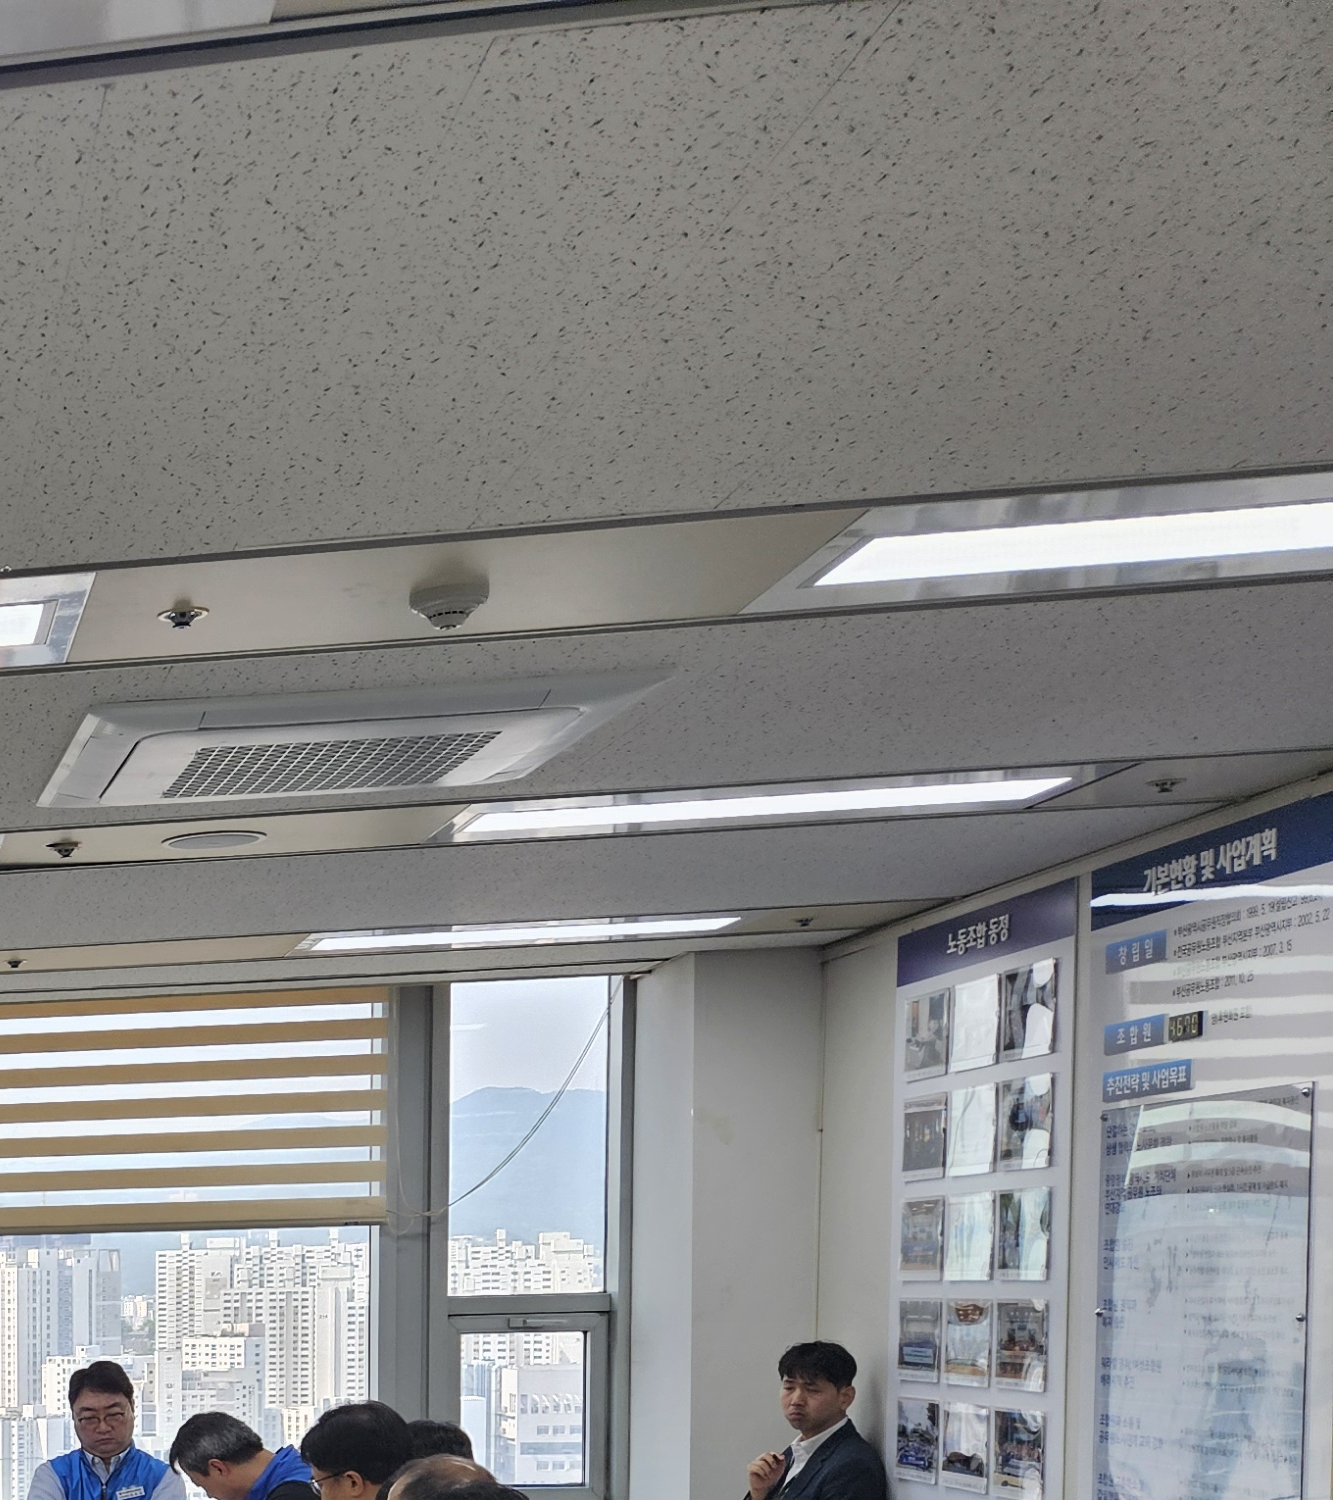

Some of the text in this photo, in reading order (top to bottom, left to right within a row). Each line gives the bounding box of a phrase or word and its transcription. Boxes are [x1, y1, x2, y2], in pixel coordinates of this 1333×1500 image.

[1143, 828, 1278, 895] 기본현황 및 사업계획
[947, 914, 1010, 955] 노동조합 동정
[1107, 1065, 1187, 1096] 추진전략 및 사업목표
